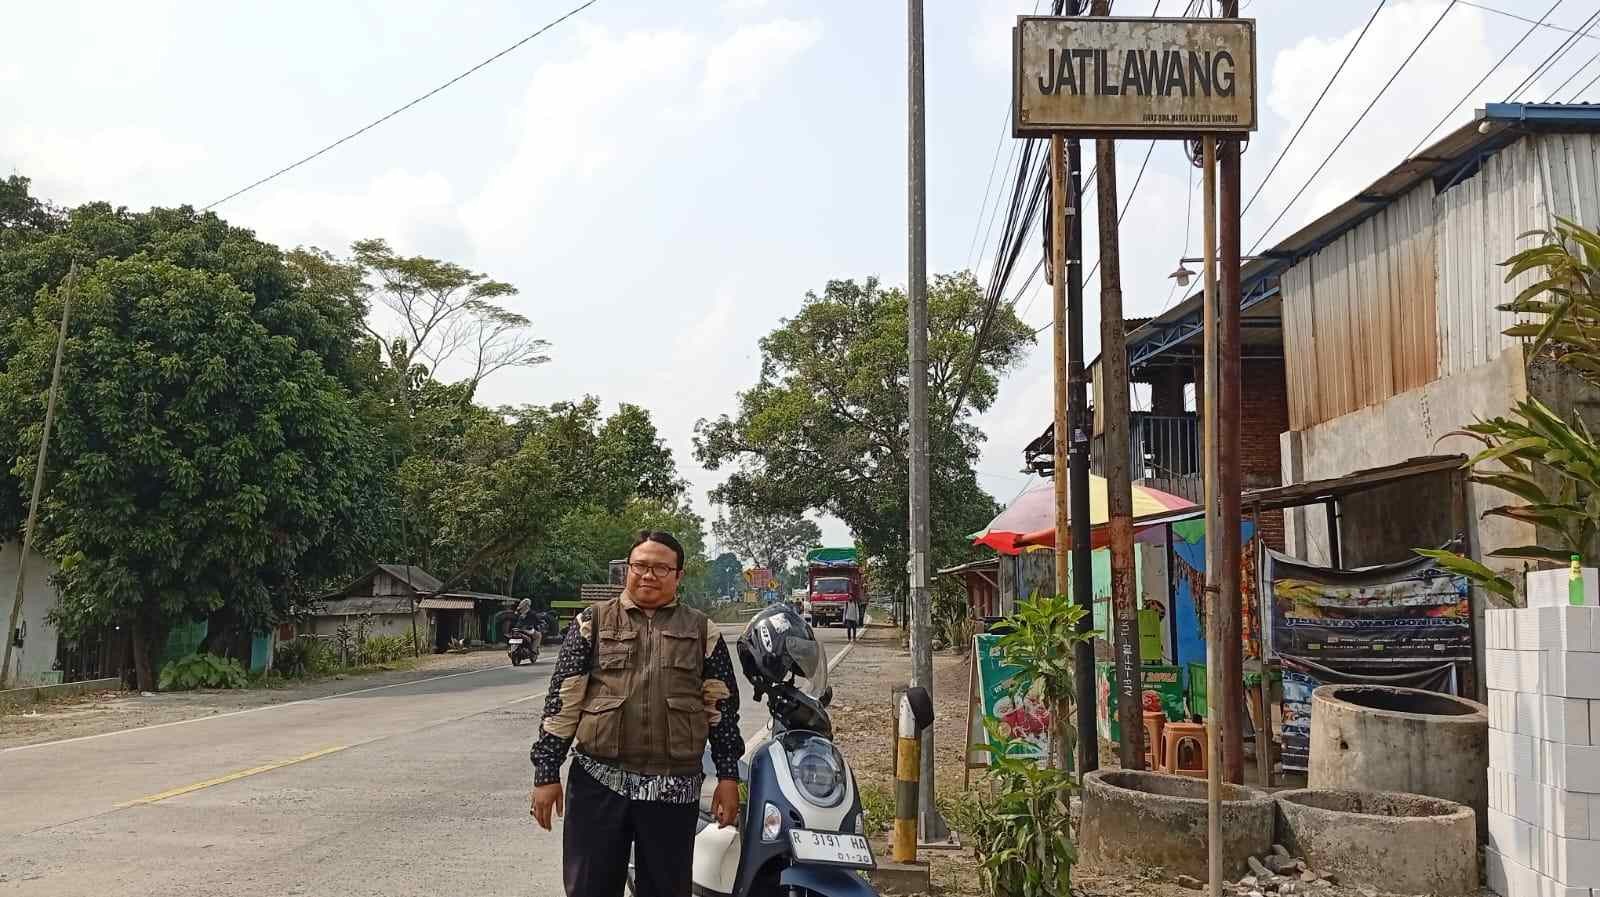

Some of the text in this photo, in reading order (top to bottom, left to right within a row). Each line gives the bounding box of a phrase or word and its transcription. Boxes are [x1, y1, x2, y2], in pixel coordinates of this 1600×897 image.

[1038, 48, 1236, 97] JATILAWANG
[793, 831, 867, 850] R 3191 HA
